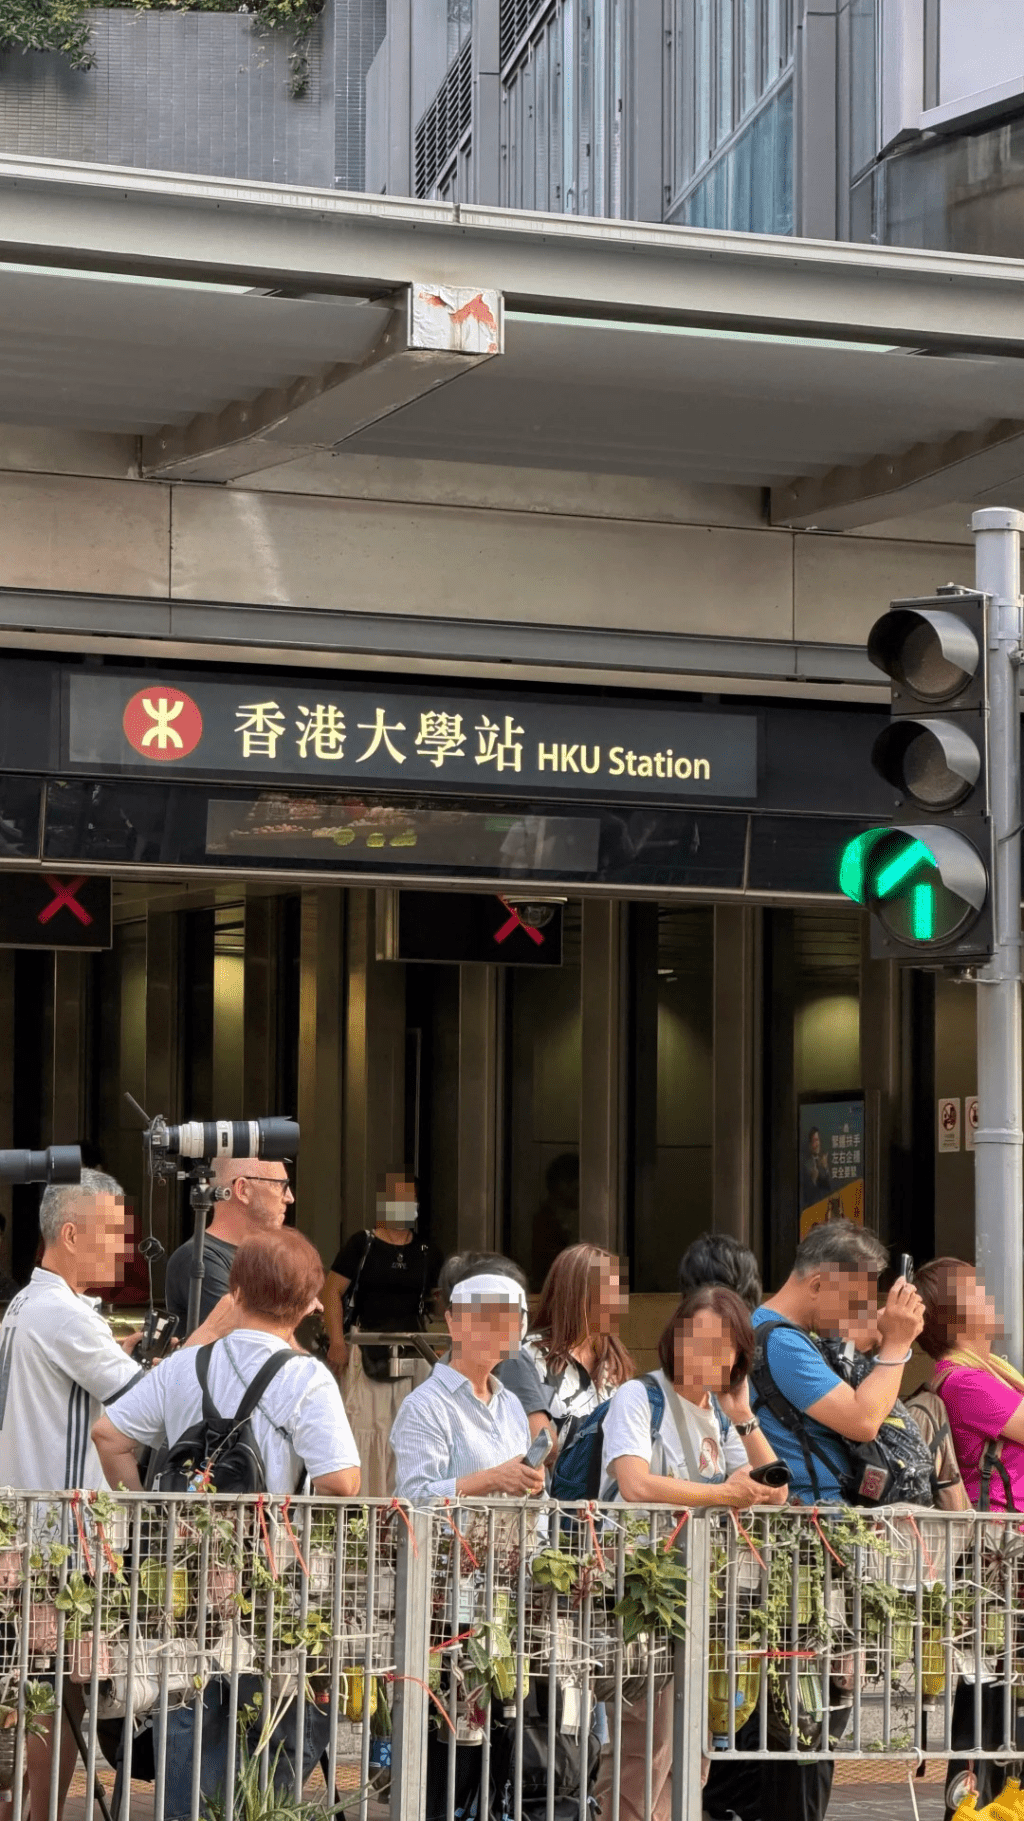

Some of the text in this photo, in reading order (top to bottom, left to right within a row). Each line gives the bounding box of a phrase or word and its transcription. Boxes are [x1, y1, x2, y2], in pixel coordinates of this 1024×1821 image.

[234, 701, 525, 772] 香港大學站
[538, 742, 711, 780] HKU Station
